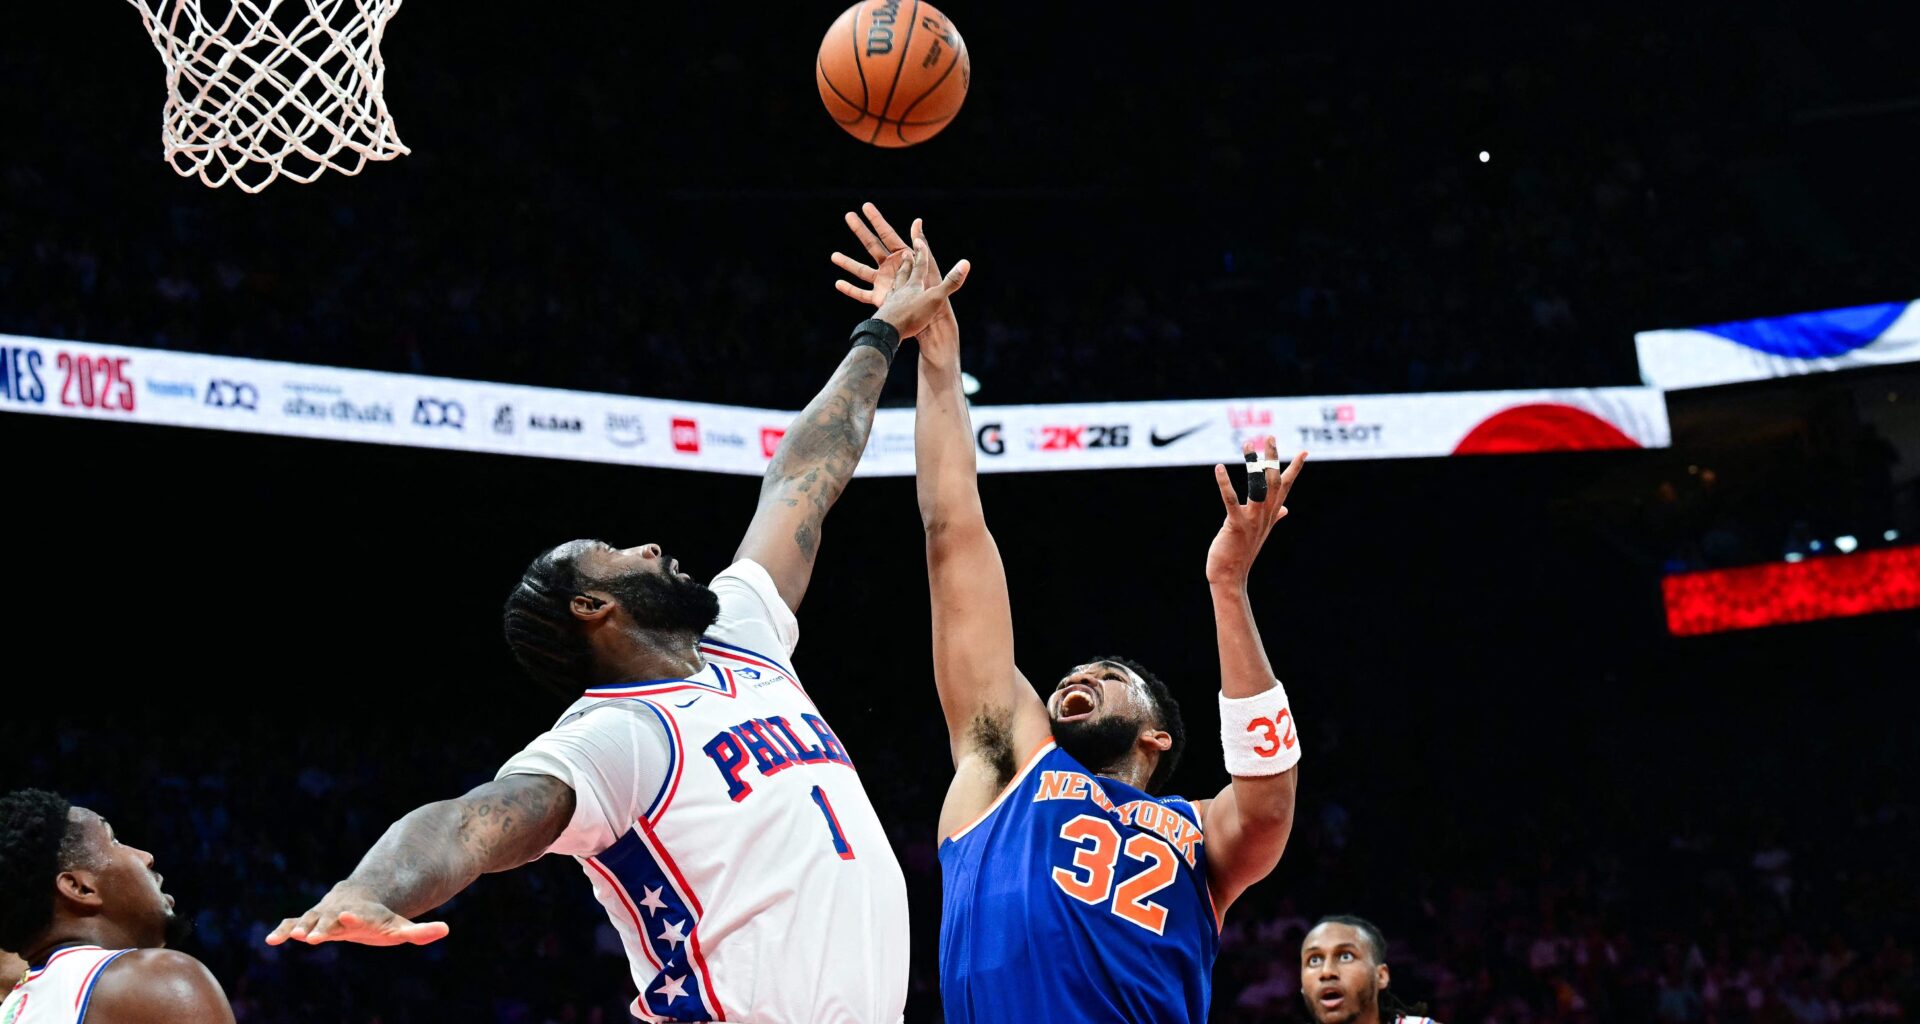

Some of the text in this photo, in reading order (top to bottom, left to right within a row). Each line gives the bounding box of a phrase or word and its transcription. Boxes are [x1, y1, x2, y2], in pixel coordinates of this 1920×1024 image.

[57, 352, 134, 411] 2025
[977, 424, 1005, 455] G
[1041, 424, 1130, 449] 2K26
[1298, 424, 1383, 443] TISSOT
[702, 713, 856, 803] PHILA
[1247, 707, 1296, 757] 32
[810, 785, 856, 860] 1
[1033, 771, 1204, 870] NEW YORK
[1052, 814, 1179, 936] 32
